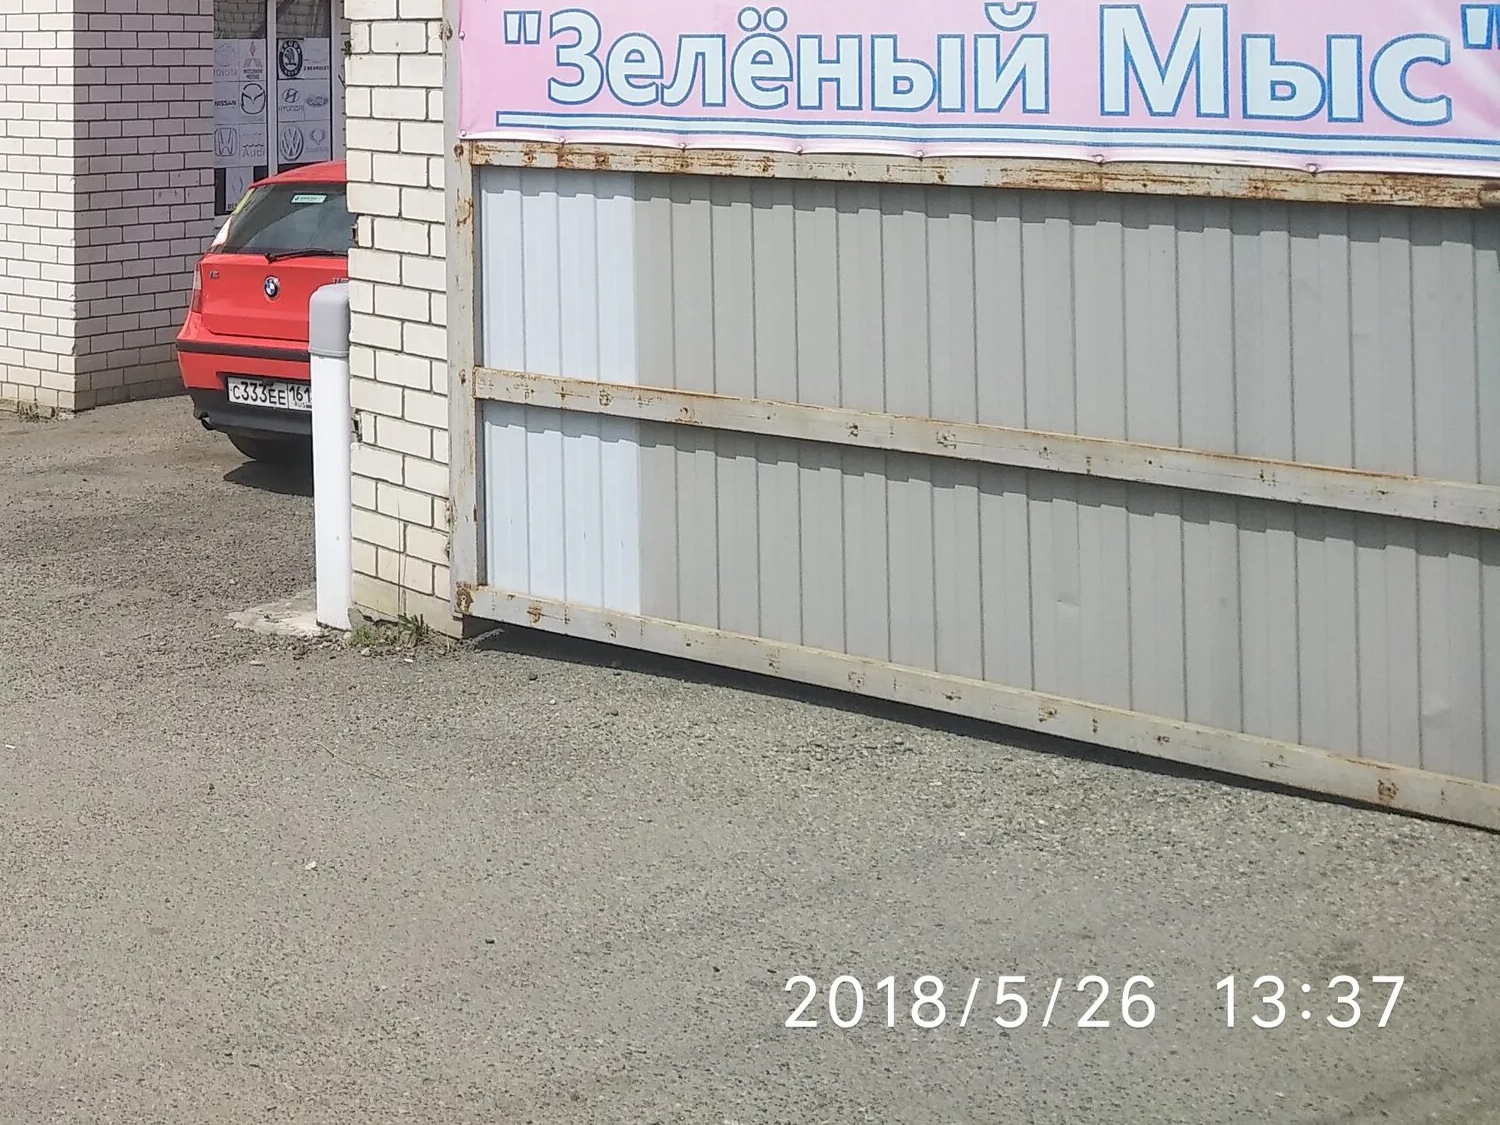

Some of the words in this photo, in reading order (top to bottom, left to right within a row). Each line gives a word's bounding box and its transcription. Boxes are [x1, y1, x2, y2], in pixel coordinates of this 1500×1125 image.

[503, 0, 1050, 117] "Зелёный
[214, 99, 237, 107] NISSAN
[242, 148, 265, 157] Audi
